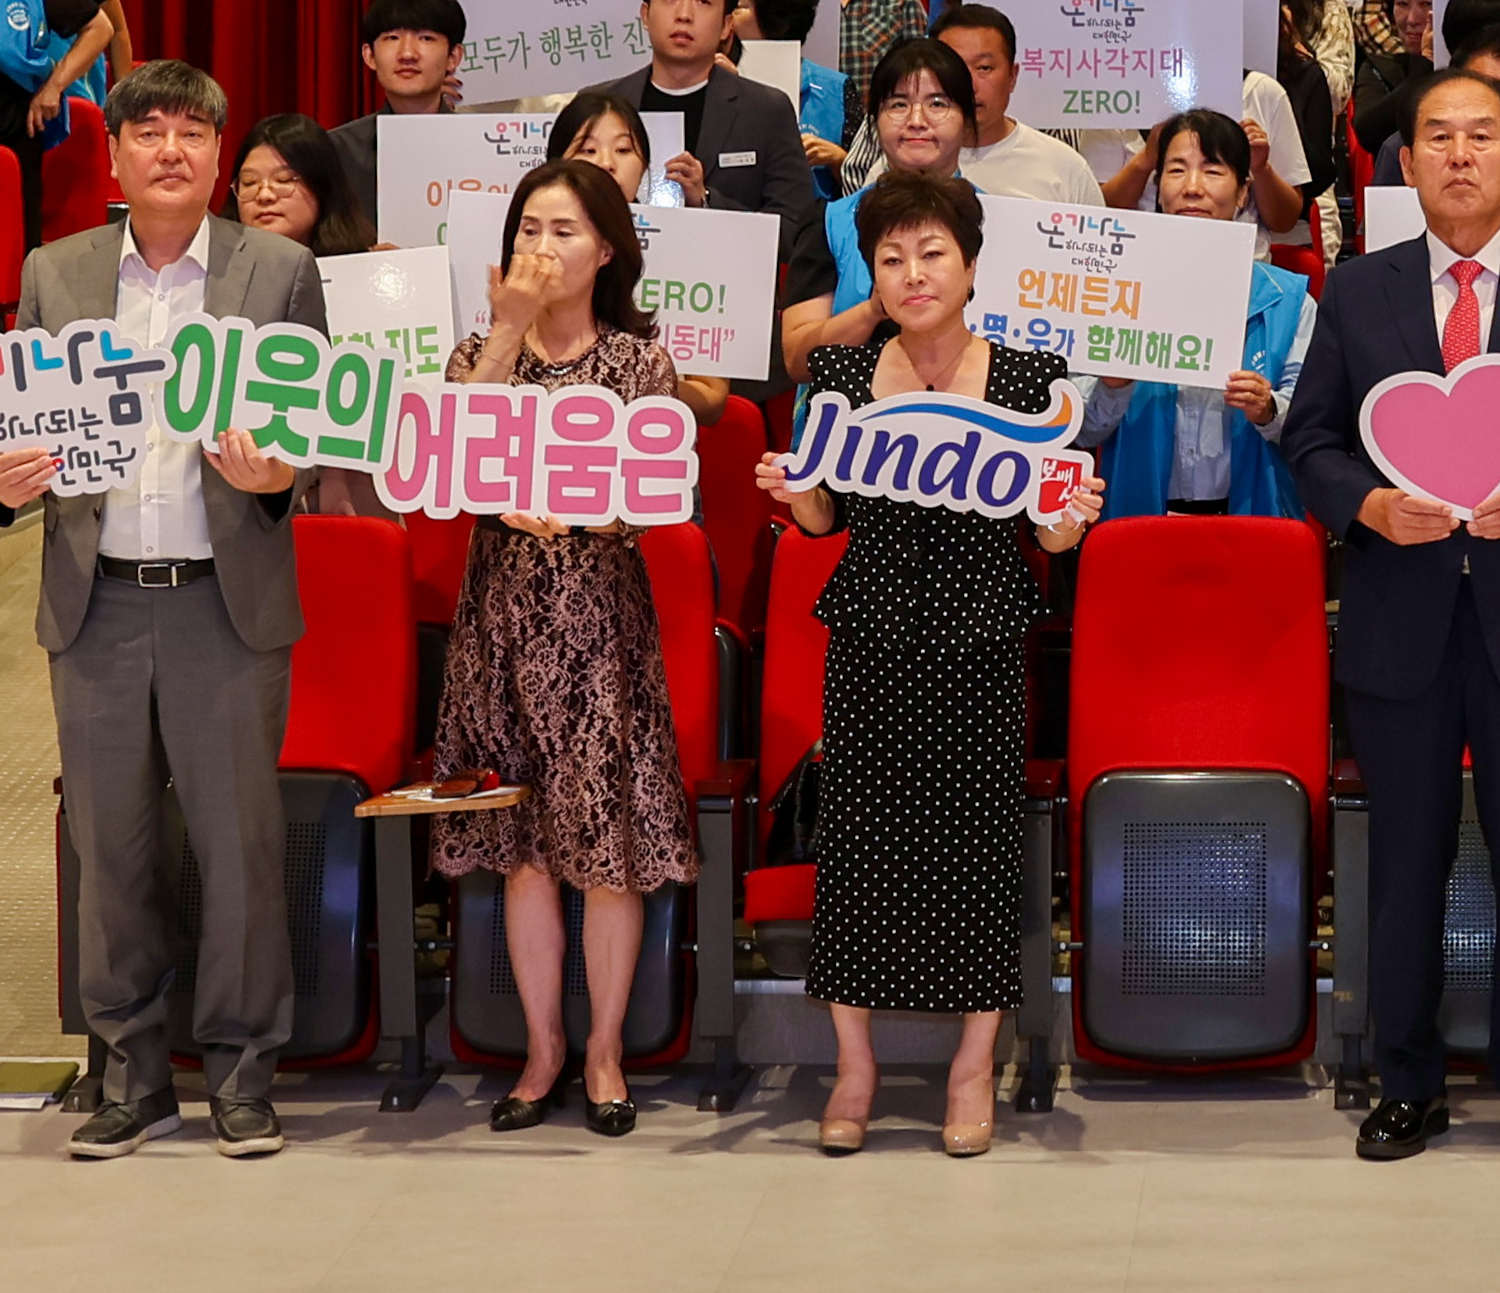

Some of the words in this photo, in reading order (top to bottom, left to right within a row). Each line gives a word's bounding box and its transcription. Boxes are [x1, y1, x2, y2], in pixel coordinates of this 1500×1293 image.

[460, 31, 531, 74] 모두가
[538, 21, 613, 66] 행복한
[623, 17, 654, 57] 진
[1021, 48, 1184, 78] 복지사각지대
[1063, 90, 1141, 114] ZERO!
[1037, 212, 1136, 256] 온기나눔
[1018, 268, 1142, 321] 언제든지
[1087, 325, 1214, 372] 함께해요!
[164, 323, 395, 464] 이웃의
[384, 392, 688, 515] 어려움은
[782, 402, 1031, 508] Jindo
